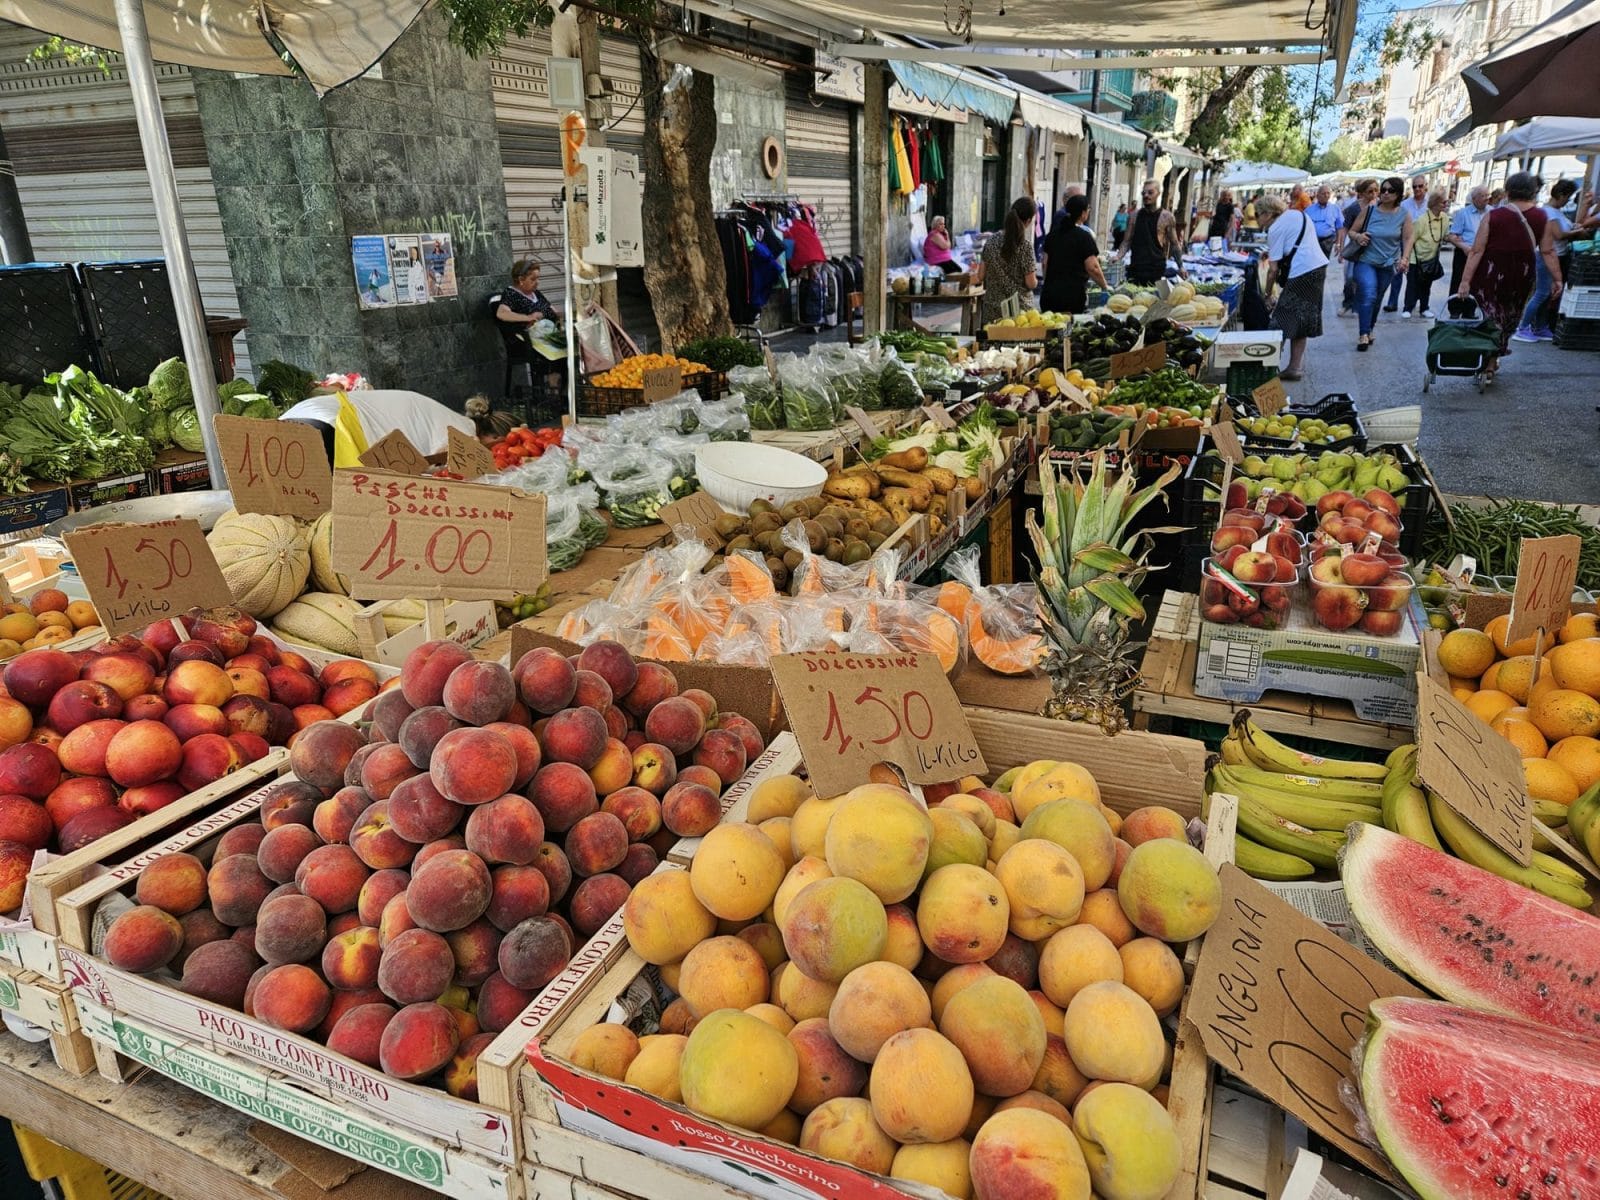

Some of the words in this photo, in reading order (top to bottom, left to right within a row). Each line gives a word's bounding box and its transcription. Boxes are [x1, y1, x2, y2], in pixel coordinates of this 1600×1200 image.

[353, 474, 449, 501] PESCHE
[104, 536, 193, 600] 1.50
[359, 518, 493, 580] 1.00
[1524, 551, 1573, 612] 2.00
[803, 656, 919, 673] DOLCISSIME
[822, 685, 934, 755] 1.50
[743, 770, 760, 779] EL
[753, 750, 781, 770] PACO
[720, 781, 752, 817] CONFIT
[111, 851, 162, 881] PACO
[165, 840, 189, 852] EL
[601, 919, 624, 937] EL
[520, 938, 611, 1028] CONFITERO
[1208, 898, 1267, 1071] ANGURIA
[148, 1053, 215, 1096] TREVISO
[196, 1008, 245, 1041] PACO
[251, 1031, 272, 1051] EL
[275, 1038, 390, 1102] CONFITERO
[226, 1037, 266, 1059] GARANTIA
[268, 1053, 280, 1064] DE
[280, 1058, 315, 1079] CALIDAD
[219, 1085, 285, 1124] FUNGHI
[291, 1116, 401, 1169] CONSORZIO
[668, 1118, 725, 1145] Rosso
[726, 1135, 841, 1191] Zuccherino
